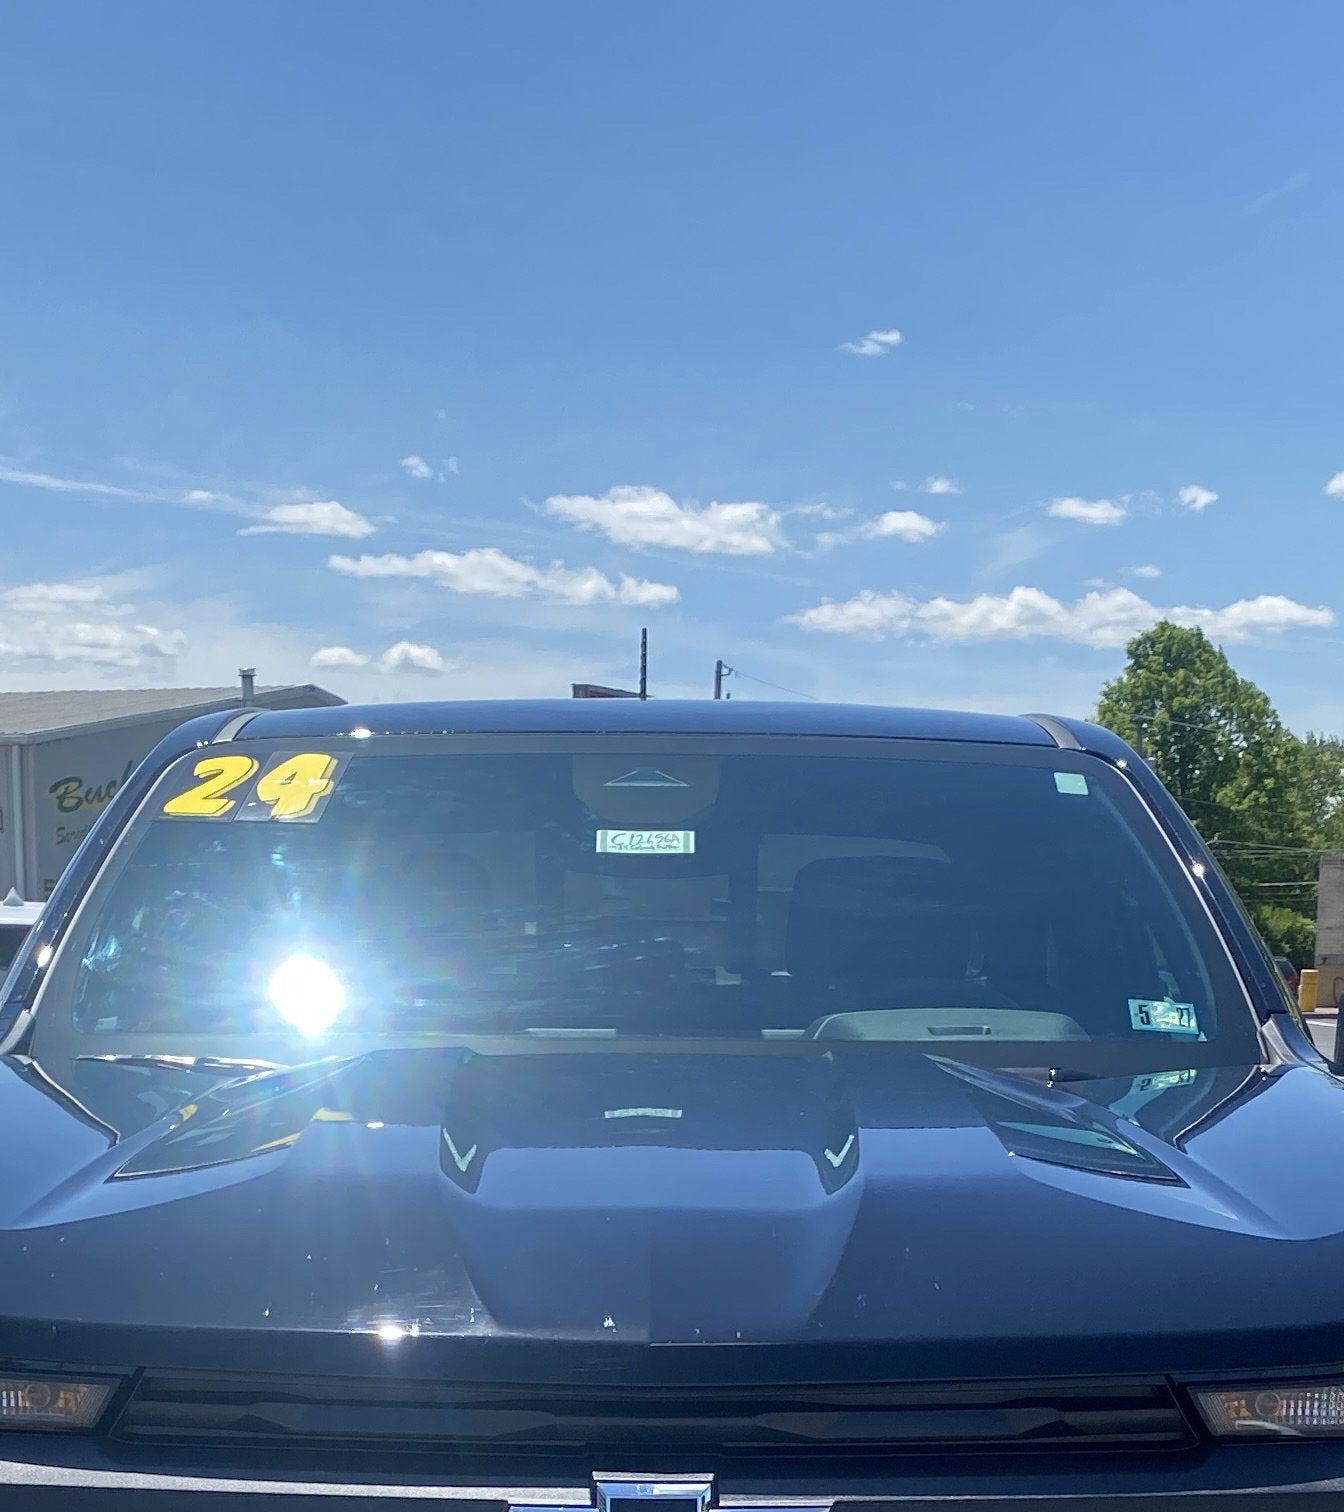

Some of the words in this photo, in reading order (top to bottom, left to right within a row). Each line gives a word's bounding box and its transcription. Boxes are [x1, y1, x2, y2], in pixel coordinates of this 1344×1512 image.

[49, 759, 134, 813] Buc
[163, 752, 338, 817] 24
[1138, 1004, 1151, 1026] 5
